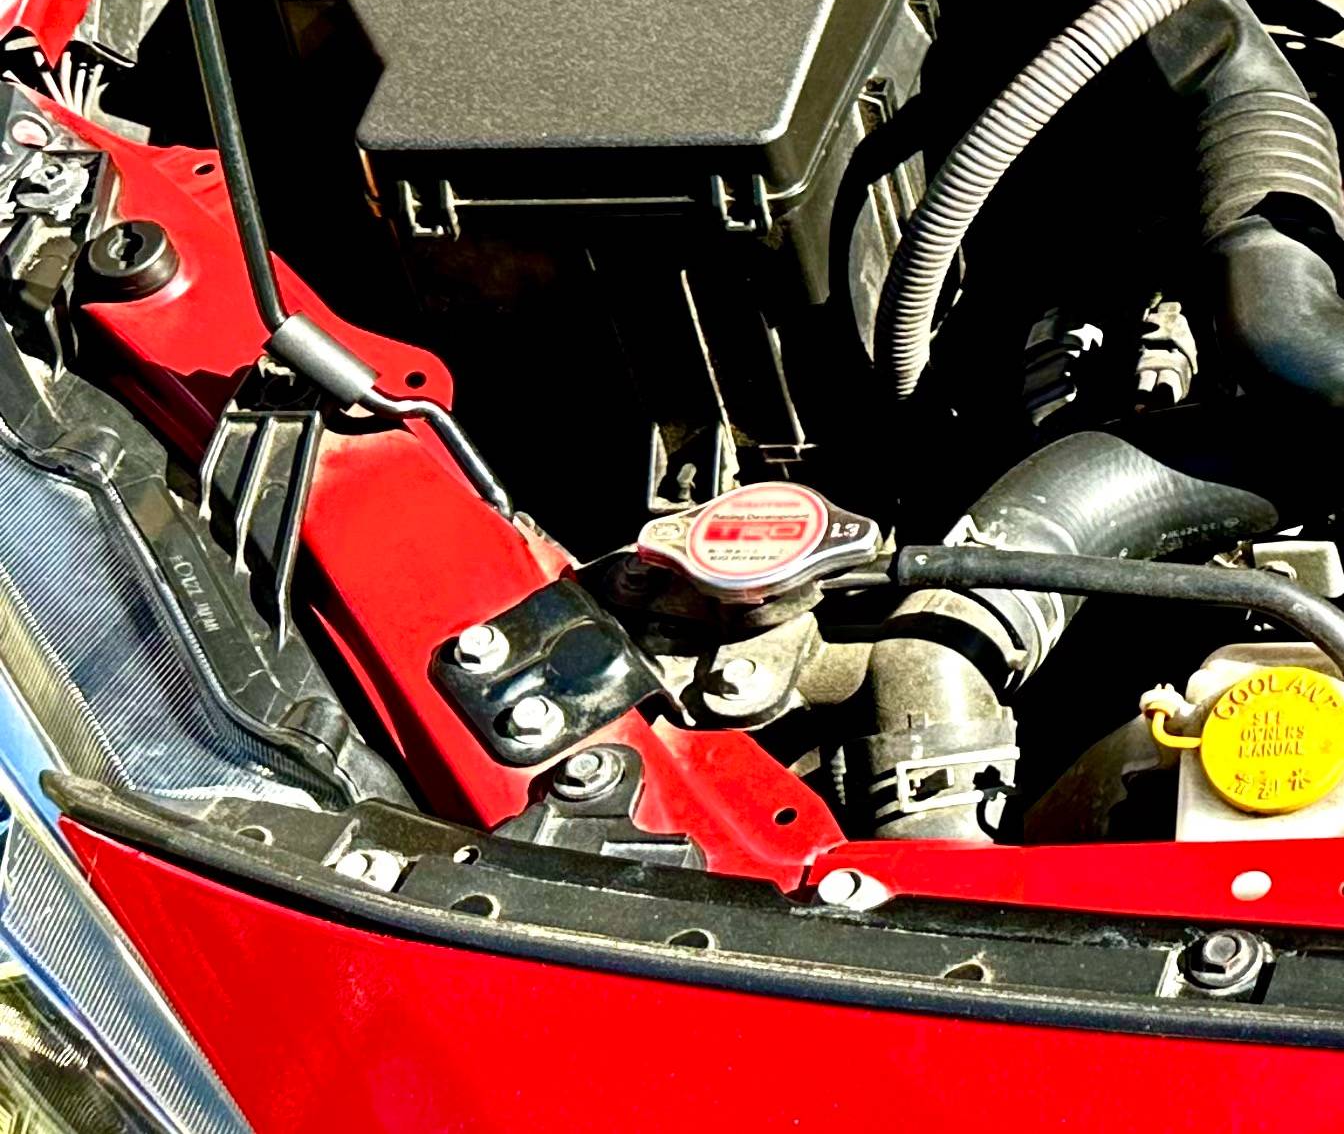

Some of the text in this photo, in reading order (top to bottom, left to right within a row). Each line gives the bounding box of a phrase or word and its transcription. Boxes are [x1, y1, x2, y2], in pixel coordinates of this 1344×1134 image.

[1213, 674, 1340, 721] COOLANT
[1252, 710, 1282, 726] SEE
[1238, 740, 1305, 759] MANUAL
